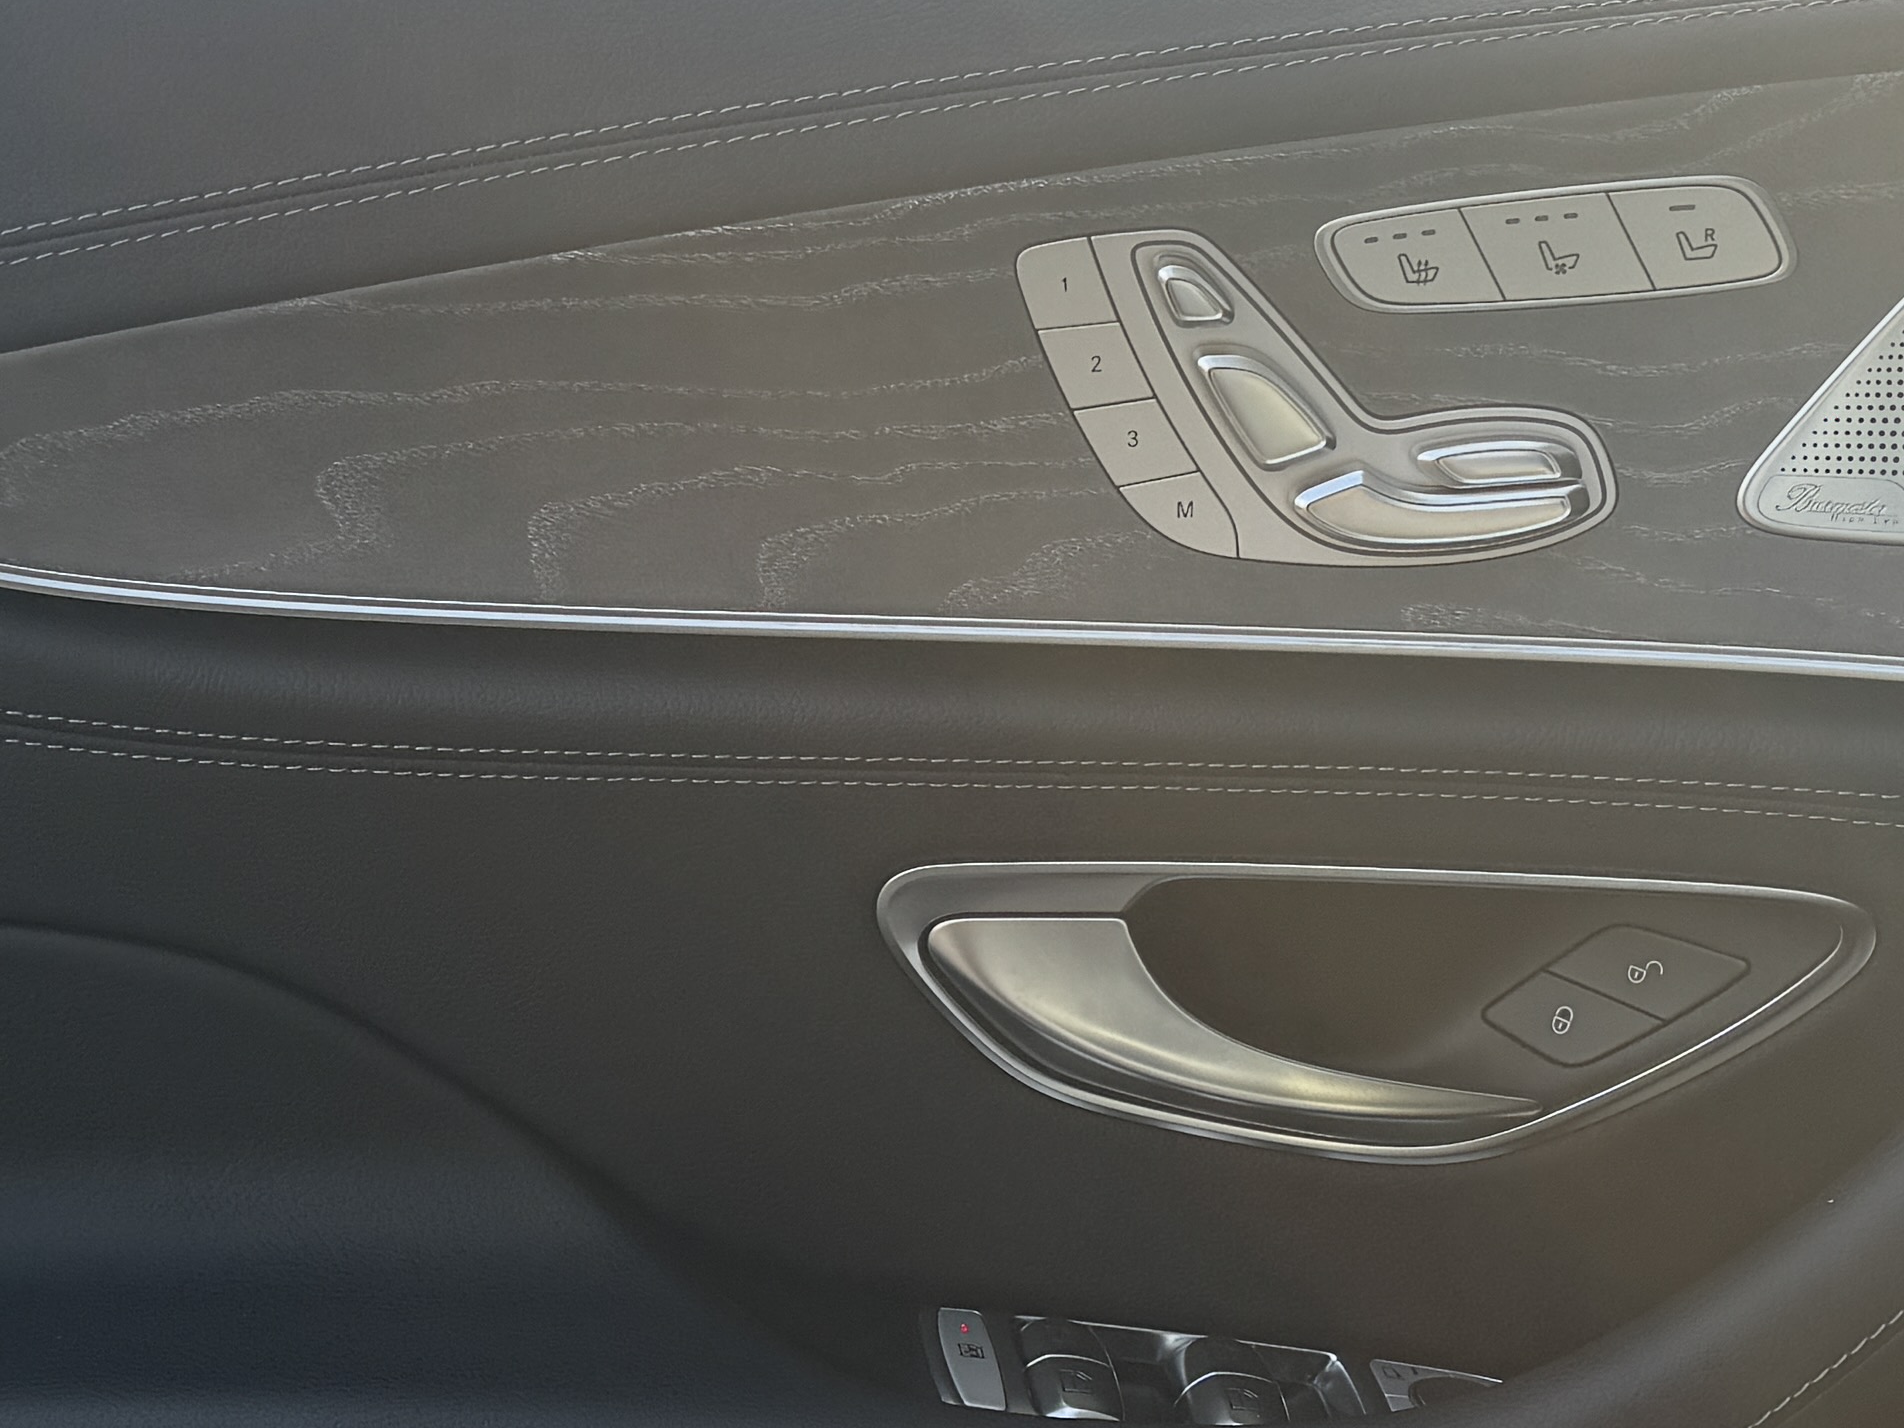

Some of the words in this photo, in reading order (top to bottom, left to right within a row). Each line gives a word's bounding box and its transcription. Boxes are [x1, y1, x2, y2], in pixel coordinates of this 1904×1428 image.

[1704, 227, 1716, 243] R
[1061, 276, 1068, 293] 1
[1090, 355, 1103, 373] 2
[1127, 429, 1139, 448] 3
[1176, 500, 1194, 519] M
